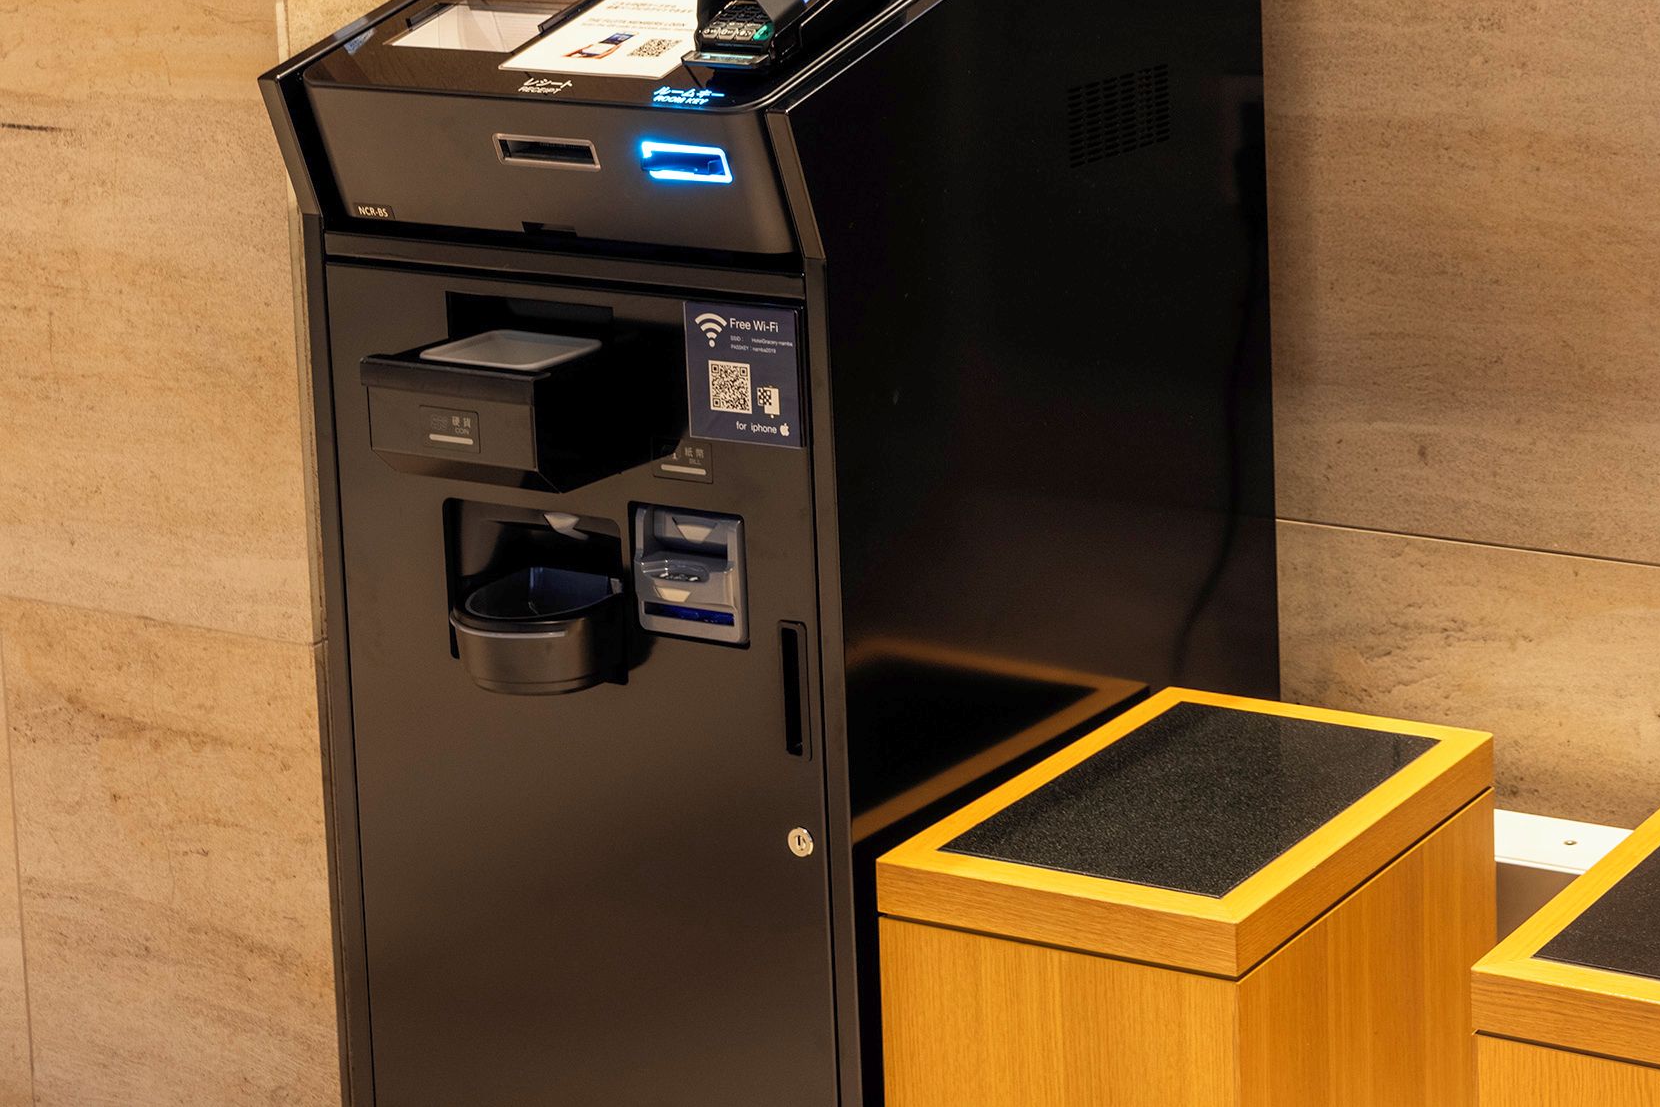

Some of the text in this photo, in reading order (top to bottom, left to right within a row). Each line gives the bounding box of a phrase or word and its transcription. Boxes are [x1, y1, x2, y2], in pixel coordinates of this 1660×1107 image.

[524, 77, 573, 88] レシート
[518, 86, 562, 95] RECEIPT
[653, 86, 725, 98] ルームキー
[652, 95, 710, 105] ROOM KEY
[358, 206, 389, 218] NCR-BS
[729, 317, 779, 333] Free Wi-Fi
[735, 421, 778, 434] for iphone
